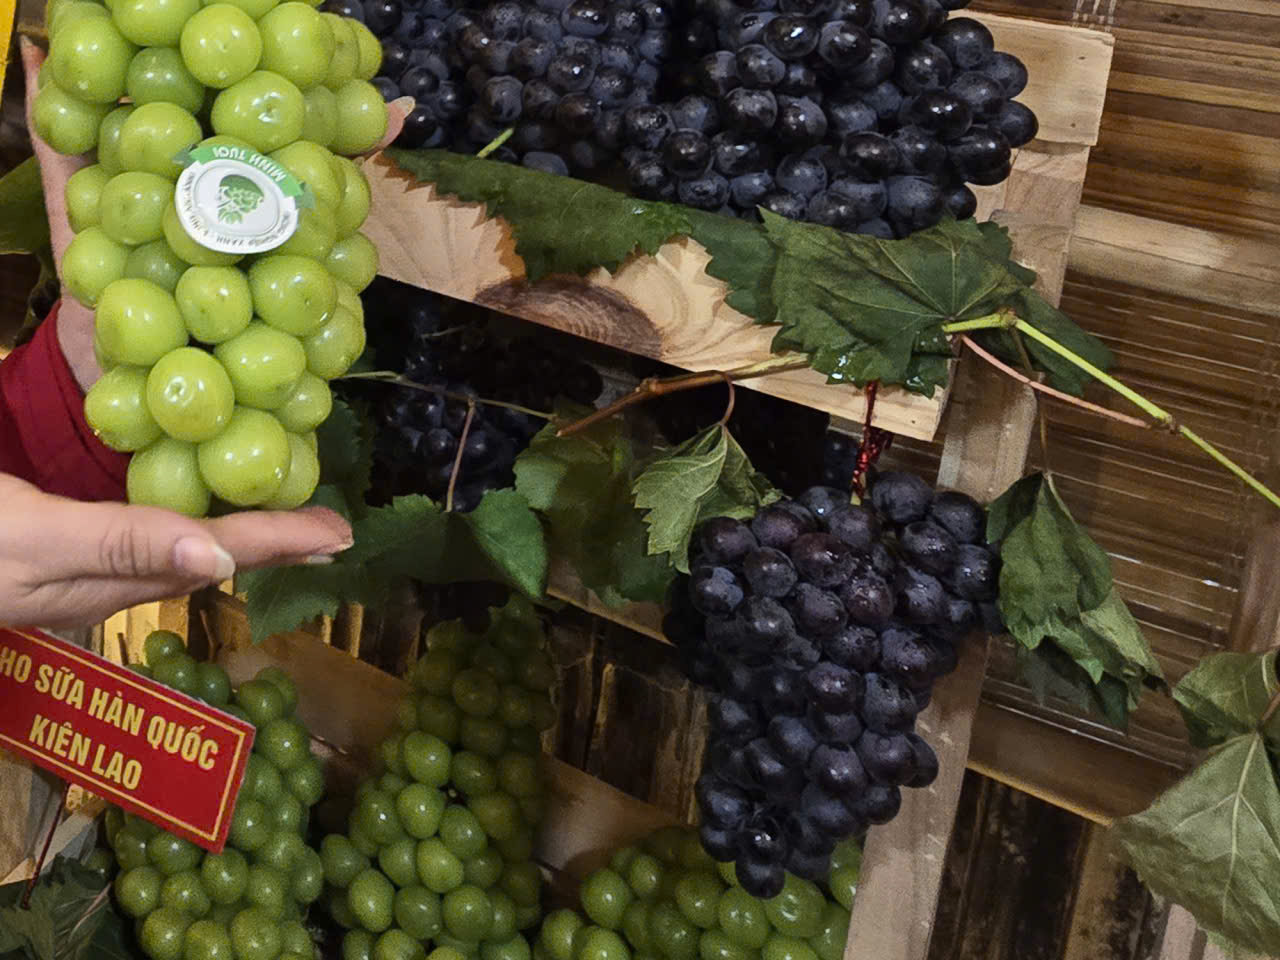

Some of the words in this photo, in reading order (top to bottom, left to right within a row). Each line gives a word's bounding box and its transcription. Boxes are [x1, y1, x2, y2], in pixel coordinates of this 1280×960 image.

[29, 714, 91, 766] KIÊN
[91, 743, 142, 790] LAO
[34, 664, 85, 710] SỮA
[87, 687, 144, 736] HÀN
[146, 715, 219, 770] QUỐC
